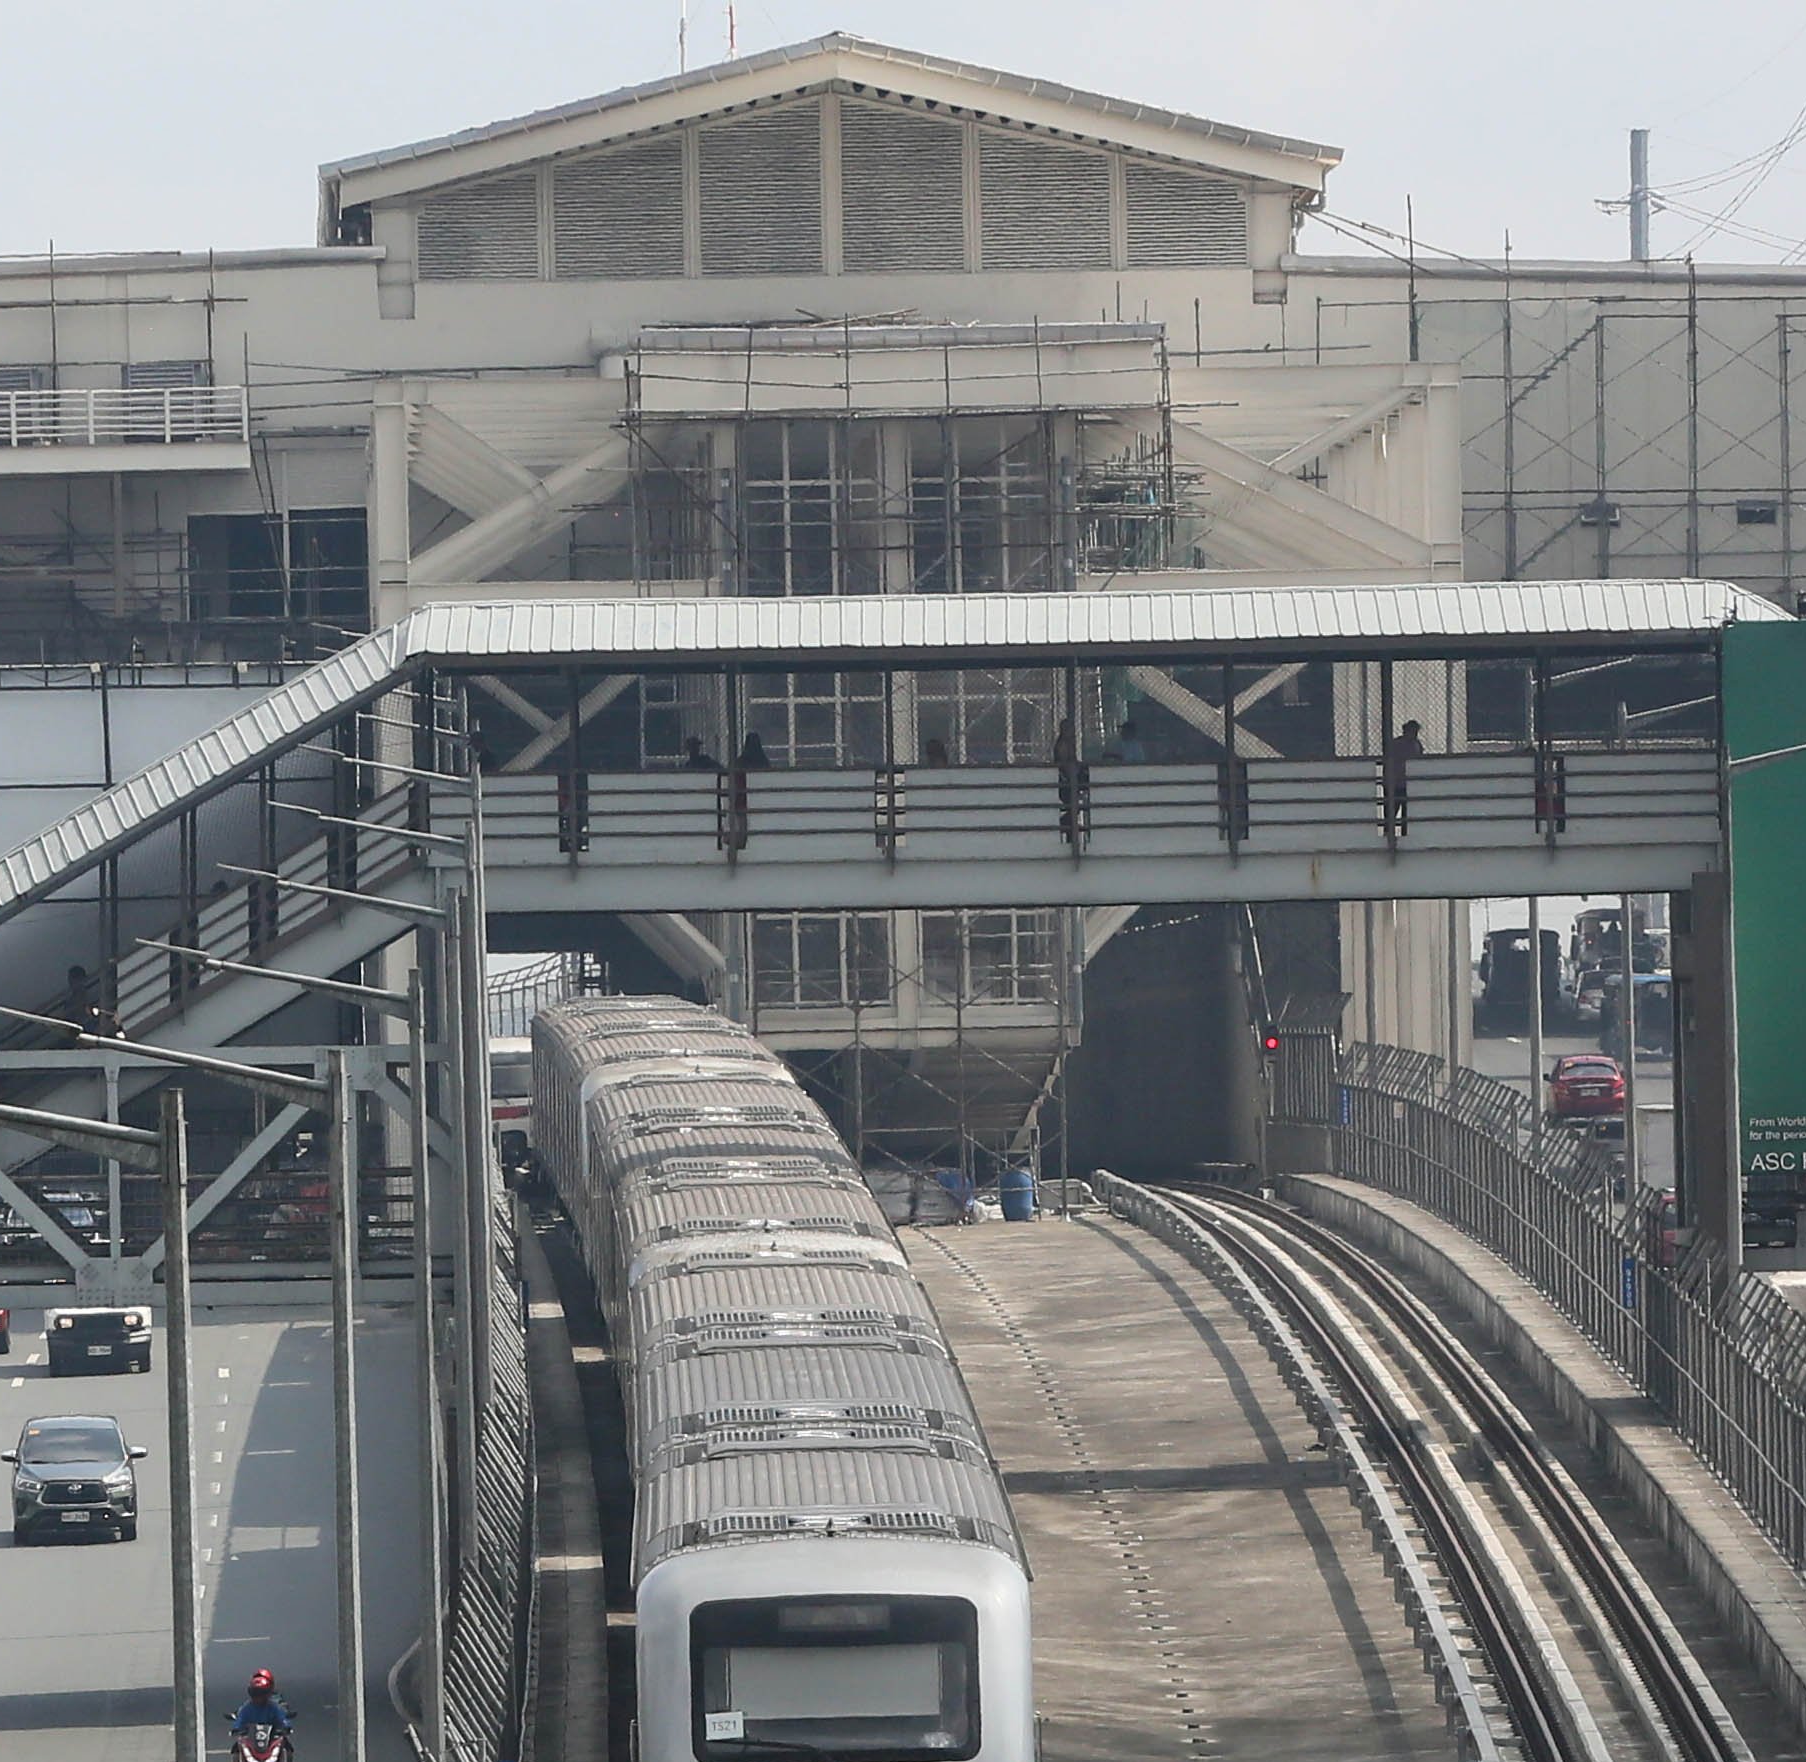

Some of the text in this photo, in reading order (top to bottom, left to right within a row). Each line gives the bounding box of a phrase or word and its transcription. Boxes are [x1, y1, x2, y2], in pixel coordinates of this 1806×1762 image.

[1749, 1118, 1776, 1127] From
[1749, 1131, 1763, 1141] for
[1765, 1130, 1781, 1140] the
[1751, 1151, 1796, 1171] ASC
